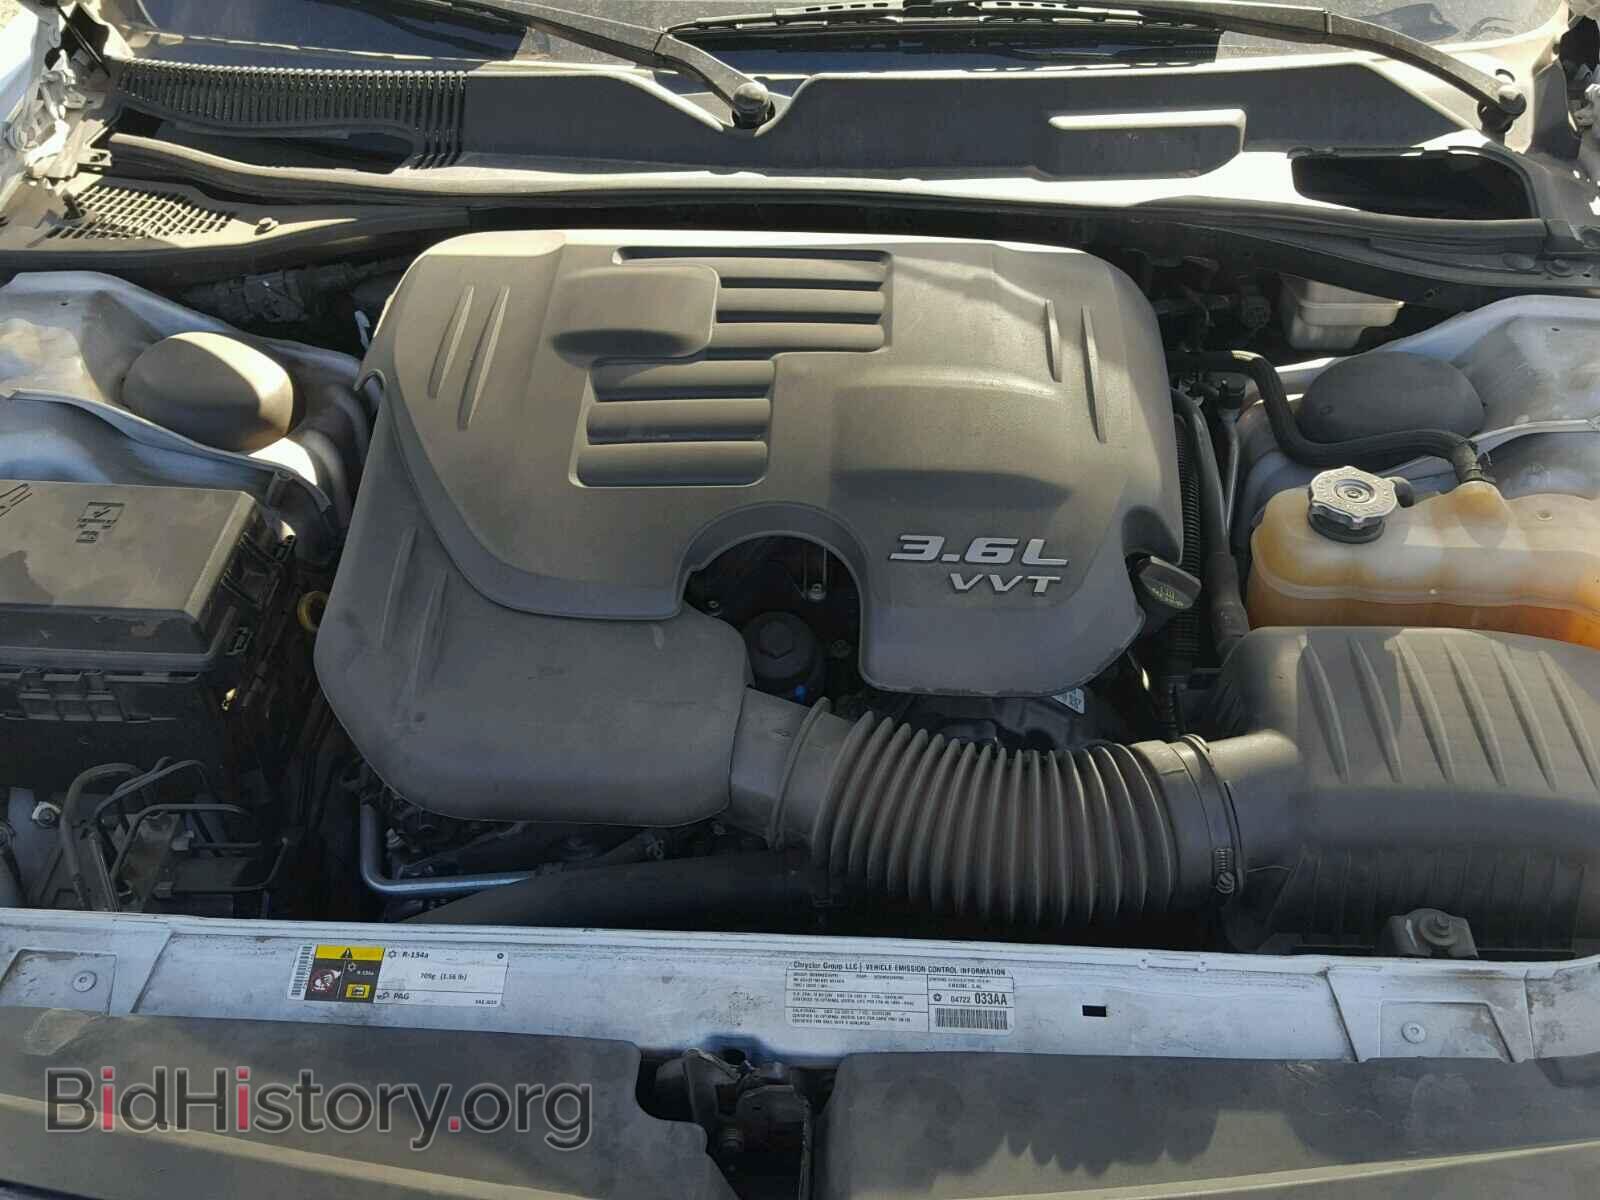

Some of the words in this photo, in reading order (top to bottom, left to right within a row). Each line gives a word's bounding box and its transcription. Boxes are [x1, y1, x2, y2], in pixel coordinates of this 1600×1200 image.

[889, 534, 1068, 565] 3.6L
[950, 573, 1061, 594] VVT
[823, 961, 843, 970] Group
[845, 962, 858, 970] LLC
[865, 963, 893, 972] VEHICLE
[895, 964, 926, 973] EMISSION
[928, 966, 957, 974] CONTROL
[960, 967, 1006, 976] INFORMATION
[393, 992, 410, 1000] PAG
[950, 995, 971, 1004] 04722
[974, 992, 1008, 1006] 033AA
